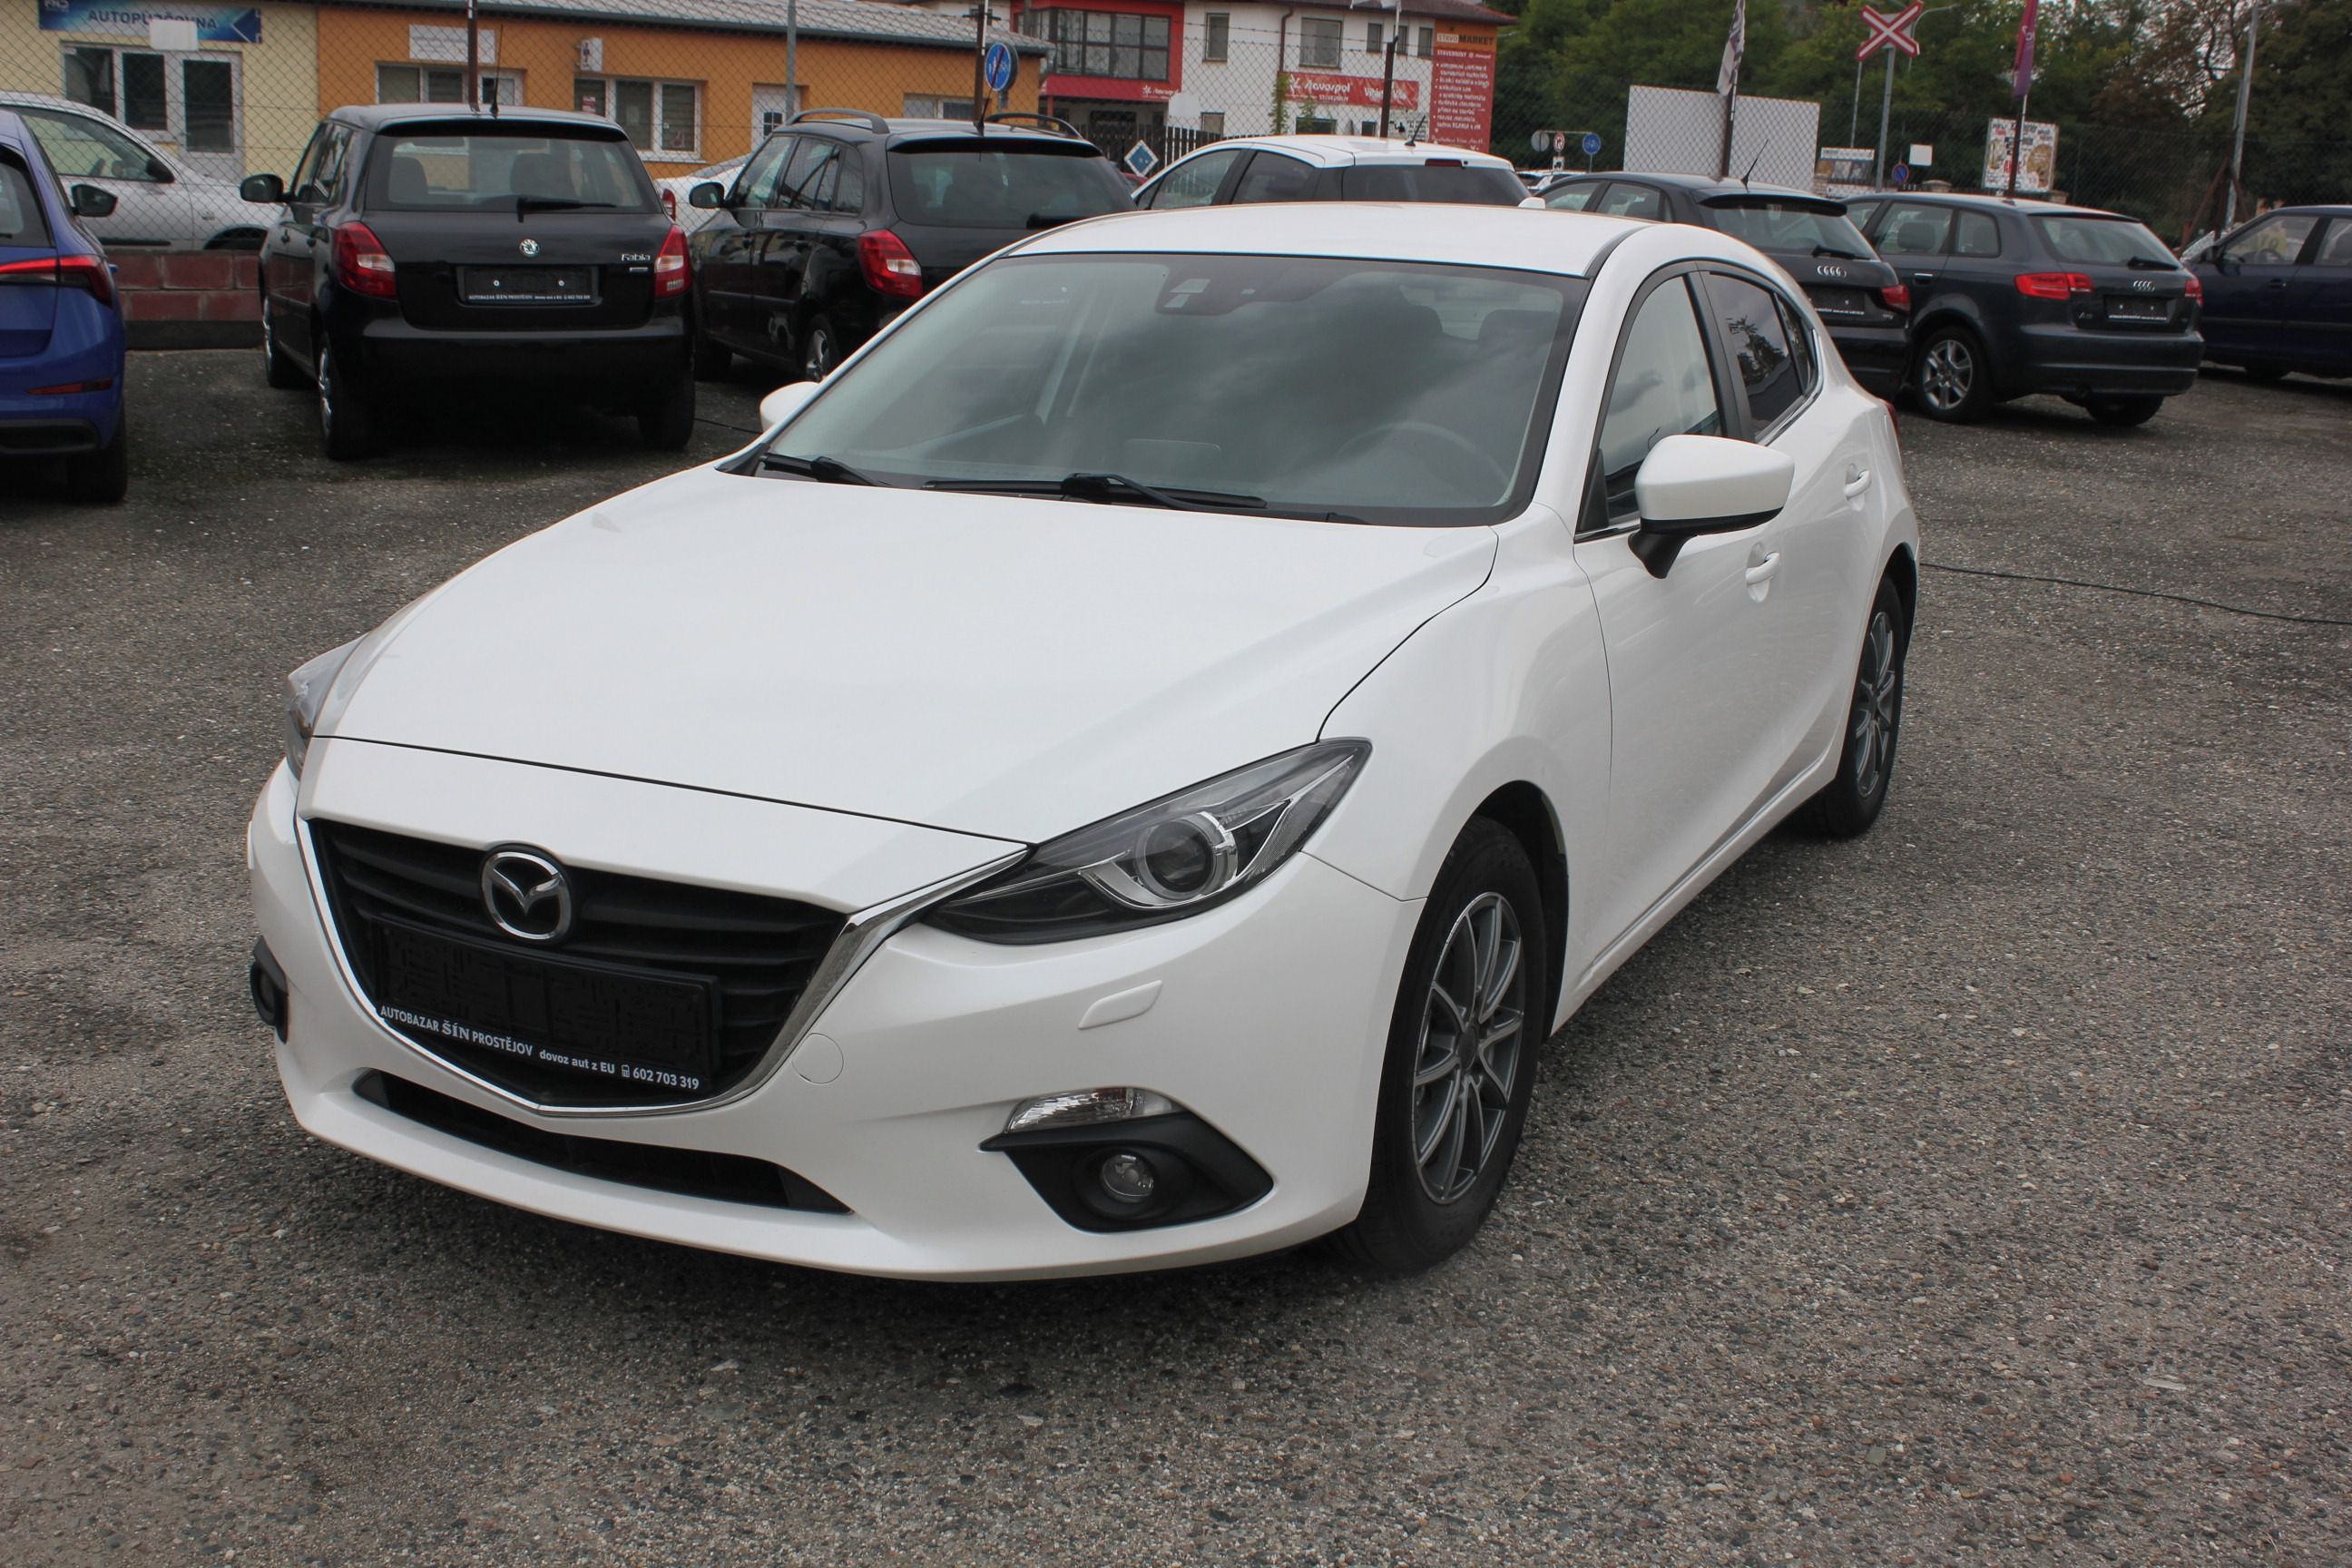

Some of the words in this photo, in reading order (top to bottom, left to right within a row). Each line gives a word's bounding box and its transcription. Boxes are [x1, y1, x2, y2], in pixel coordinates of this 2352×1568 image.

[621, 253, 652, 262] Fabia
[380, 1004, 439, 1032] AUTOBAZAR
[441, 1019, 470, 1041] ŠÍN
[472, 1031, 534, 1056] PROSTĚJOV
[539, 1049, 569, 1065] dovoz
[571, 1056, 590, 1069] aut
[591, 1062, 598, 1071] z
[600, 1062, 615, 1074] EU
[632, 1067, 654, 1082] 602
[656, 1071, 677, 1086] 703
[680, 1075, 700, 1090] 319
